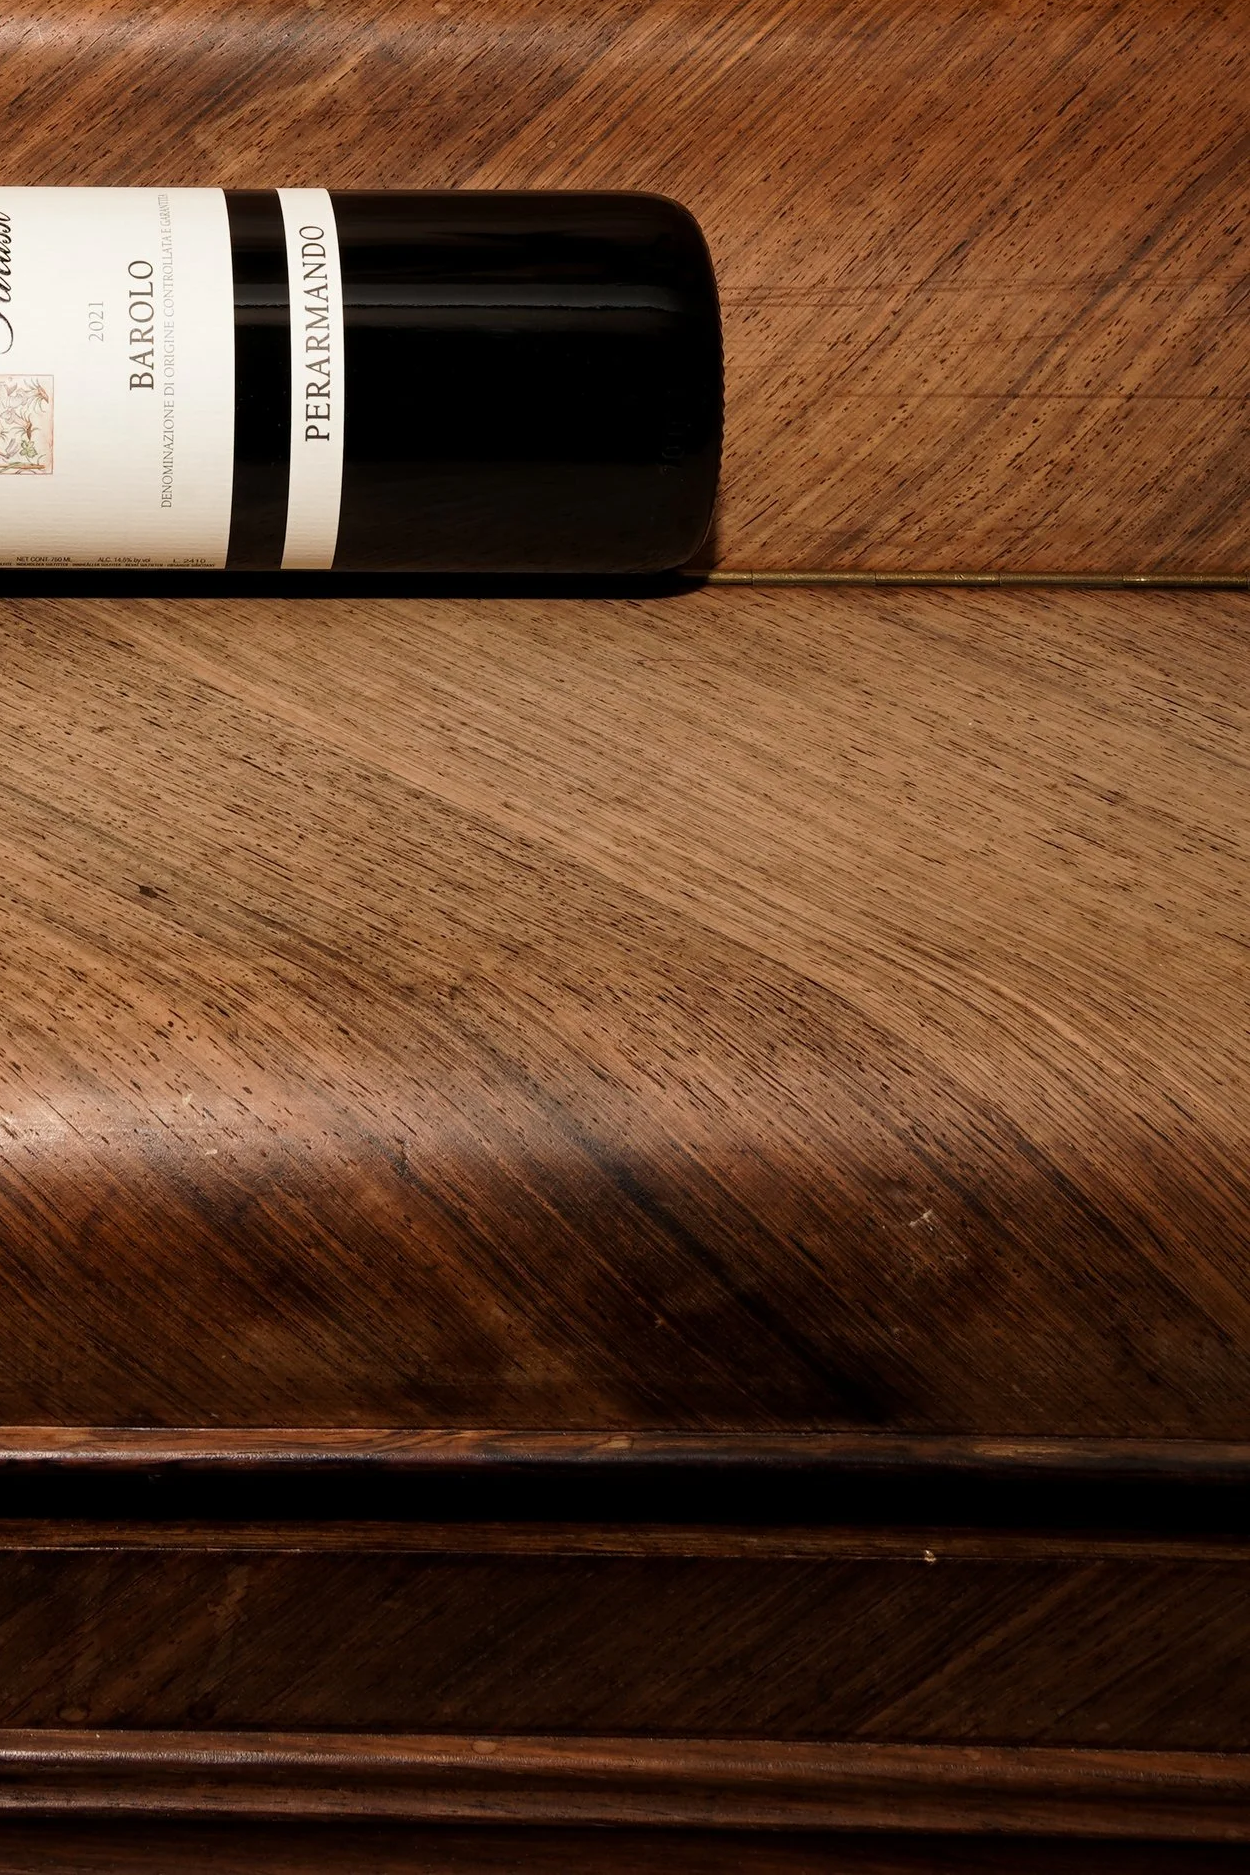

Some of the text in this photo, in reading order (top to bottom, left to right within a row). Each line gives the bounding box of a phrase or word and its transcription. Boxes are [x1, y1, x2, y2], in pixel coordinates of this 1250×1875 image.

[161, 235, 175, 317] CONTROLLATA
[88, 300, 105, 343] 2021
[128, 259, 155, 391] BAROLO
[163, 321, 175, 378] ORIGINE
[299, 225, 331, 443] PERARMANDO
[163, 381, 175, 396] DI
[160, 400, 175, 508] DENOMINAZIONE
